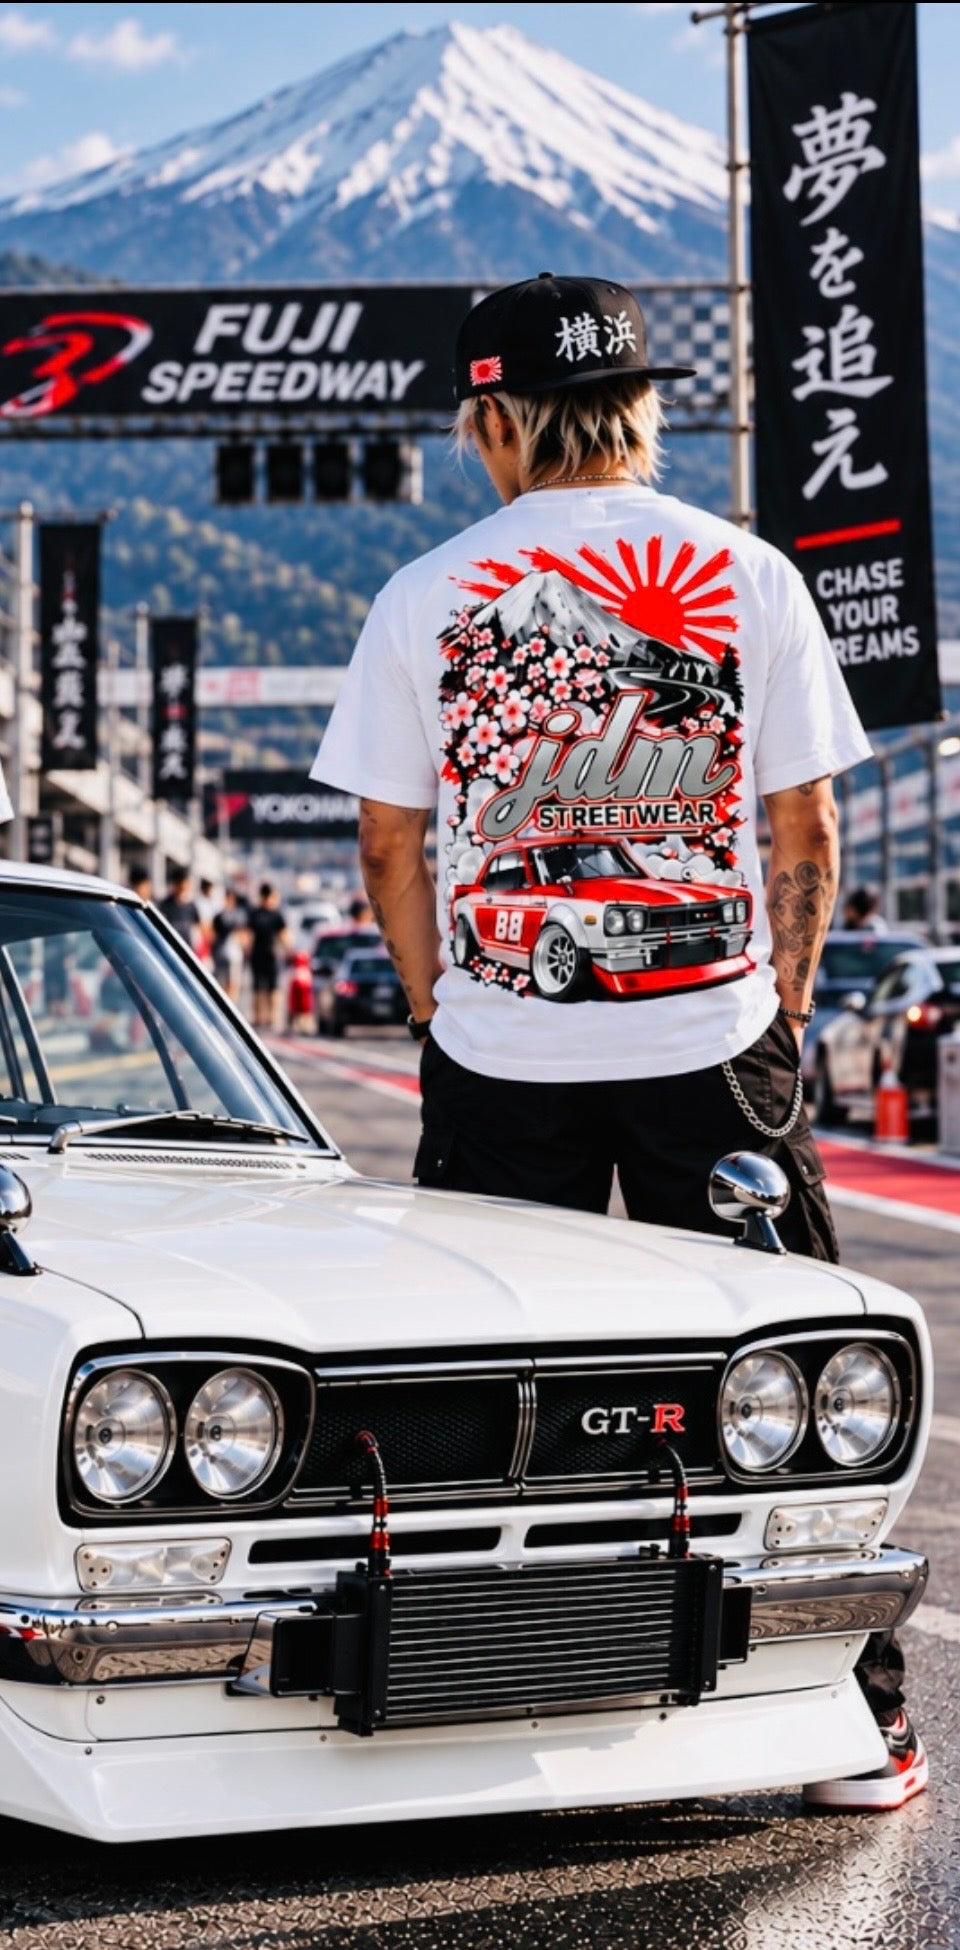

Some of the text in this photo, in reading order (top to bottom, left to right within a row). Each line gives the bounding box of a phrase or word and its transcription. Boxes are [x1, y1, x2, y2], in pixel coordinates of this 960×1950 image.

[782, 91, 894, 500] 夢を追え
[194, 302, 363, 354] FUJI
[555, 311, 637, 362] 横浜
[141, 360, 425, 403] SPEEDWAY
[816, 557, 904, 599] CHASE
[827, 594, 899, 632] YOUR
[832, 625, 920, 666] REAMS
[478, 690, 737, 841] jdm
[539, 803, 717, 828] STREETWEAR
[494, 911, 524, 941] 88
[581, 1403, 686, 1435] GT-R
